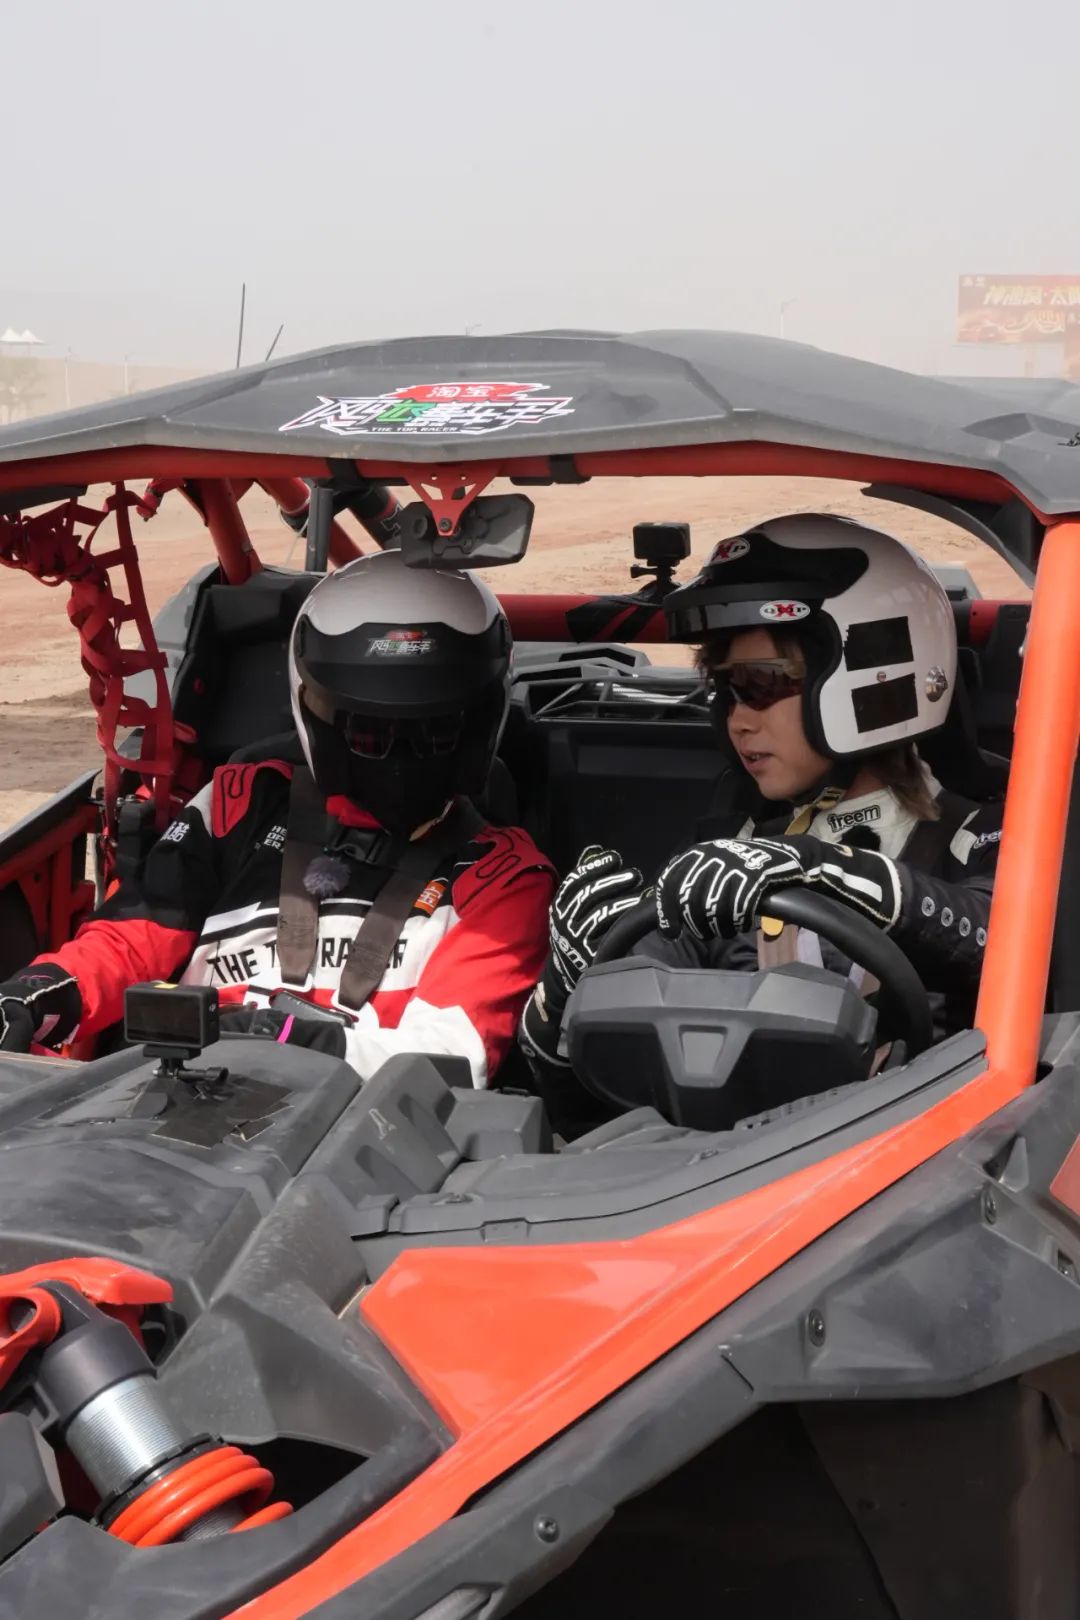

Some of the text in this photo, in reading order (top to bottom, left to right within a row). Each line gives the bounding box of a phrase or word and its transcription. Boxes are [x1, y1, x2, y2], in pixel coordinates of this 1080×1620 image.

[427, 384, 496, 397] 淘宝
[828, 806, 880, 831] freem
[206, 948, 260, 984] THE
